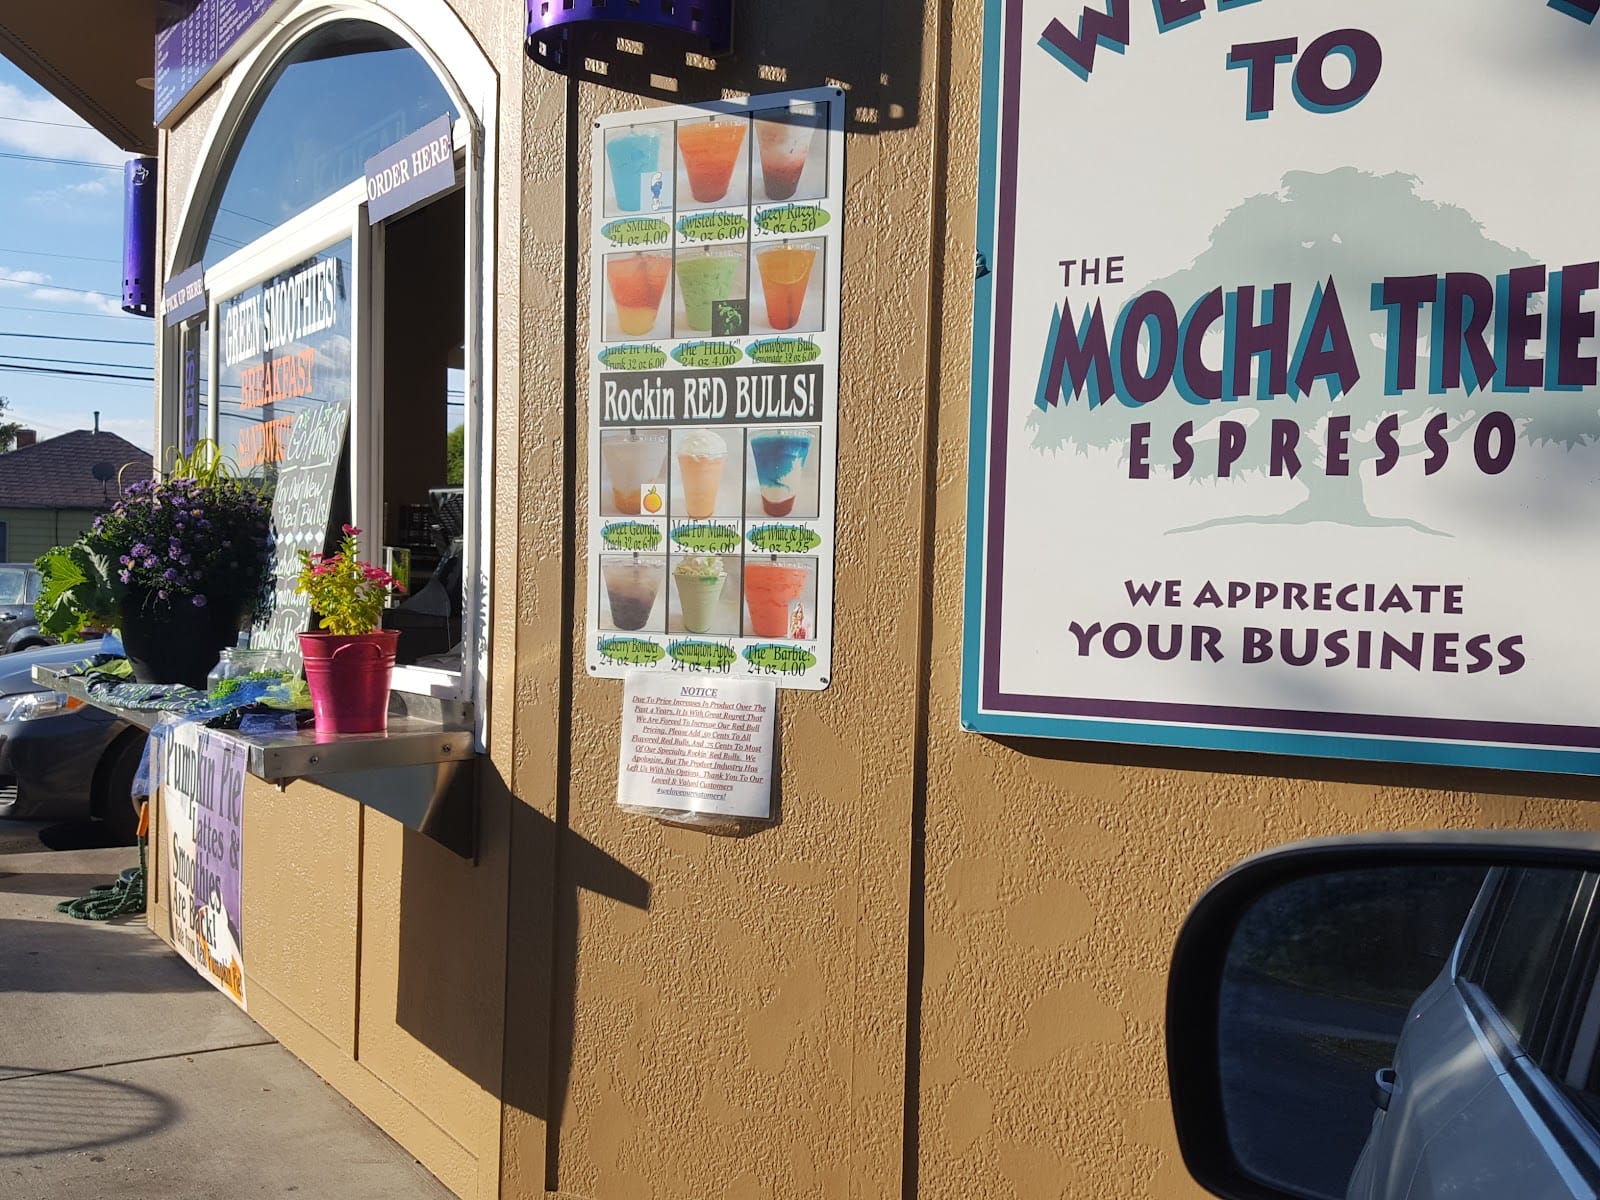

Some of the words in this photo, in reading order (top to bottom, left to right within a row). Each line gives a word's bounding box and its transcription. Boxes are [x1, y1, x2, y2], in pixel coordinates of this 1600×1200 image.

[1225, 28, 1383, 121] TO
[367, 159, 410, 200] ORDER
[411, 135, 450, 177] HERE
[680, 210, 716, 230] Twisted
[718, 212, 743, 227] Sister
[755, 205, 783, 222] Sazzy
[787, 200, 821, 220] Razzy!
[680, 231, 697, 243] 32
[700, 232, 713, 242] oz
[717, 226, 745, 240] 6.00
[754, 223, 769, 236] 32
[773, 224, 786, 235] oz
[789, 217, 816, 234] 6.50
[610, 234, 623, 248] 24
[627, 236, 640, 246] oz
[643, 230, 668, 246] 4.00
[1059, 256, 1125, 288] THE
[225, 293, 261, 368] GREEN
[263, 256, 337, 353] SMOOTHIES!
[753, 336, 796, 354] Strawberry
[798, 334, 815, 351] Bull
[1035, 274, 1360, 413] MOCHA
[1370, 261, 1600, 396] TREE
[679, 340, 697, 356] The
[681, 357, 694, 367] 24
[698, 358, 709, 366] oz
[711, 355, 736, 366] 4.00
[240, 347, 315, 411] BREAKFAST
[604, 376, 676, 422] Rockin
[683, 376, 728, 420] RED
[735, 373, 816, 420] BULLS!
[287, 413, 306, 460] Go
[1127, 411, 1517, 479] ESPRESSO
[304, 472, 328, 499] New
[278, 500, 300, 528] Red
[301, 489, 332, 529] Bulls!
[692, 520, 706, 537] For
[624, 537, 632, 551] 32
[633, 540, 641, 550] oz
[674, 542, 688, 553] 32
[692, 543, 705, 553] oz
[709, 542, 735, 553] 6.00
[751, 542, 764, 553] 24
[769, 544, 781, 553] oz
[784, 542, 809, 554] 5.25
[1124, 579, 1182, 608] WE
[1193, 580, 1464, 614] APPRECIATE
[746, 645, 766, 661] The
[1068, 621, 1226, 664] YOUR
[1242, 627, 1527, 676] BUSINESS
[600, 653, 613, 666] 24
[616, 656, 629, 666] oz
[631, 655, 658, 668] 4.75
[671, 659, 684, 672] 24
[688, 662, 701, 673] oz
[705, 660, 731, 675] 4.50
[747, 660, 761, 674] 24
[765, 663, 777, 675] oz
[781, 662, 806, 676] 4.00
[680, 687, 718, 698] NOTICE
[753, 704, 767, 712] The
[712, 731, 730, 739] Cents
[717, 721, 730, 729] Our
[731, 722, 744, 730] Red
[660, 737, 673, 745] Red
[714, 741, 732, 749] Cents
[733, 742, 743, 750] To
[744, 743, 761, 751] Most
[709, 750, 723, 759] Red
[745, 753, 757, 761] We
[166, 726, 215, 820] Pumpkin
[219, 741, 242, 826] Pie
[725, 771, 739, 780] You
[739, 772, 748, 780] To
[749, 773, 764, 781] Our
[192, 807, 224, 861] Lattes
[230, 829, 240, 871] &
[173, 832, 222, 914] Smoothies
[173, 881, 186, 923] Are
[189, 895, 217, 950] Back!
